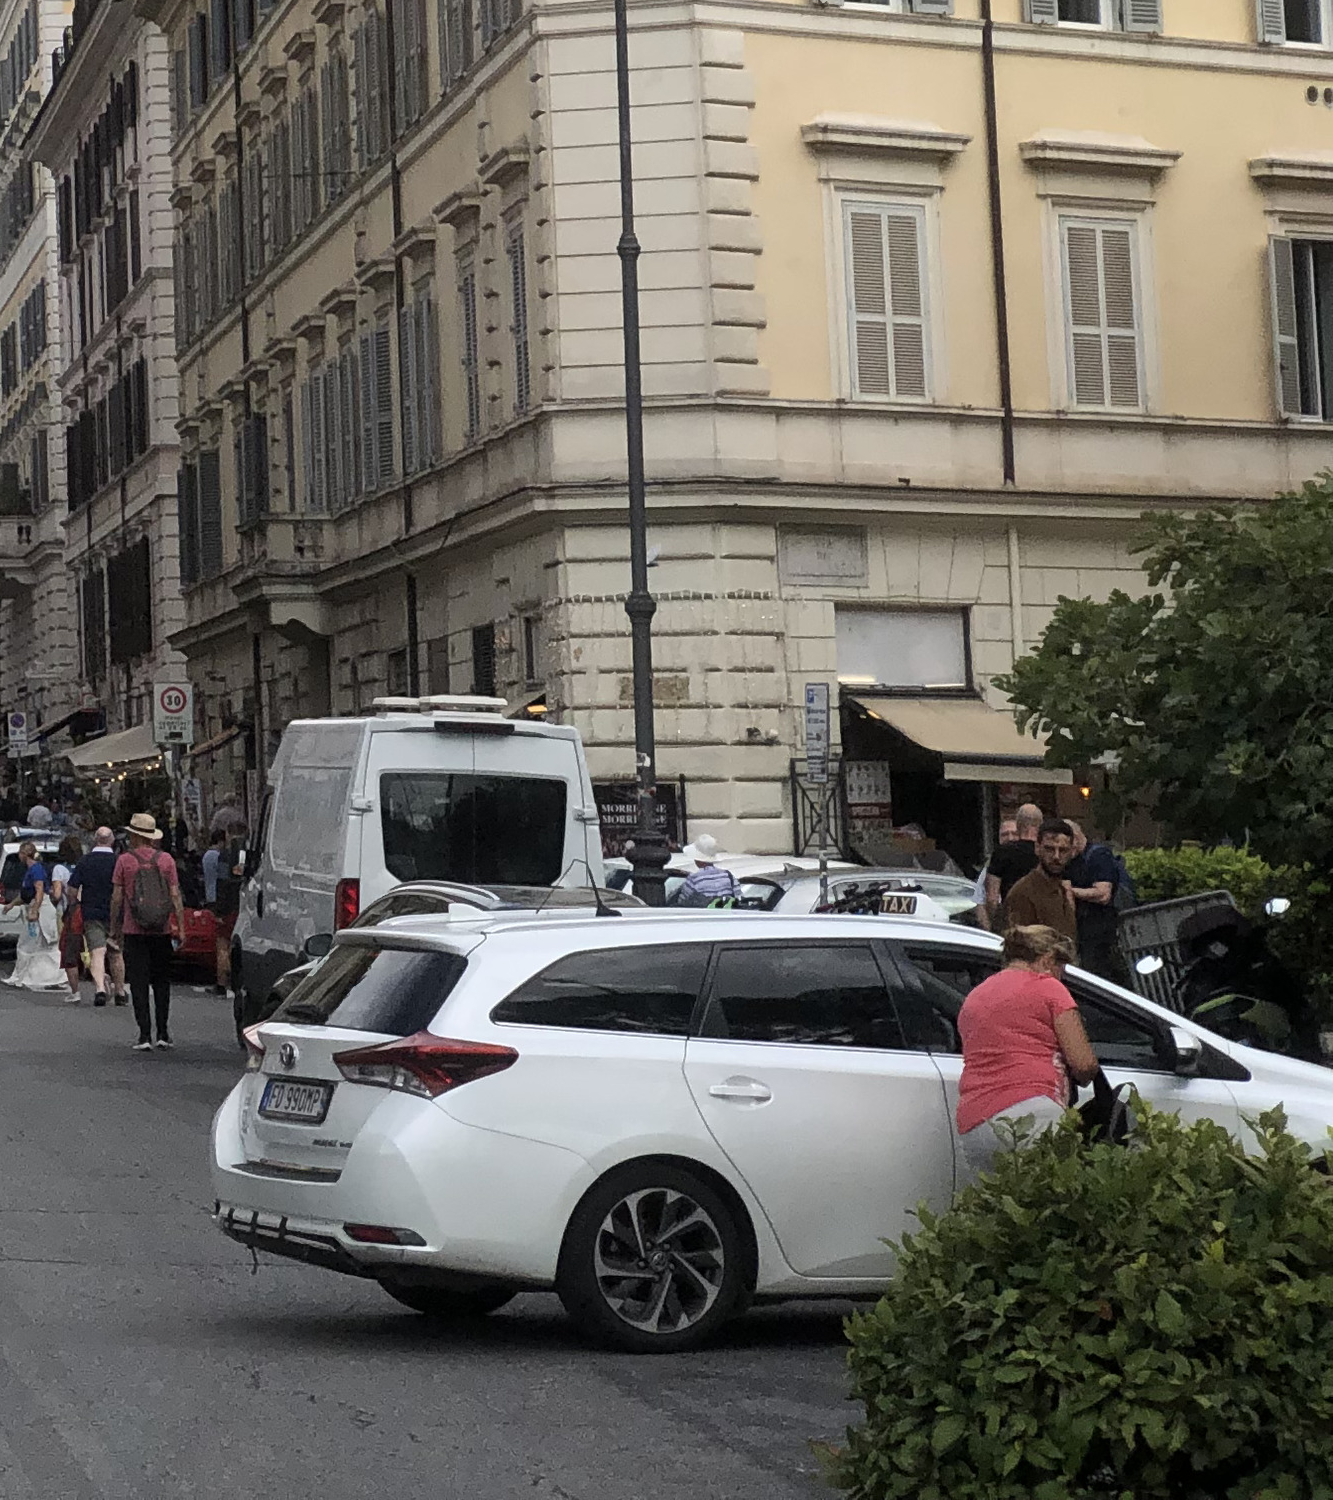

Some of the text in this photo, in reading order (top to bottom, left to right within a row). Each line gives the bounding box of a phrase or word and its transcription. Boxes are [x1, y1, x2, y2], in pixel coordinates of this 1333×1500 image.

[166, 695, 181, 706] 30
[601, 804, 667, 813] MORRIE
[602, 815, 667, 824] MORRIE
[883, 896, 915, 913] TAXI
[268, 1085, 321, 1113] FD 990MP
